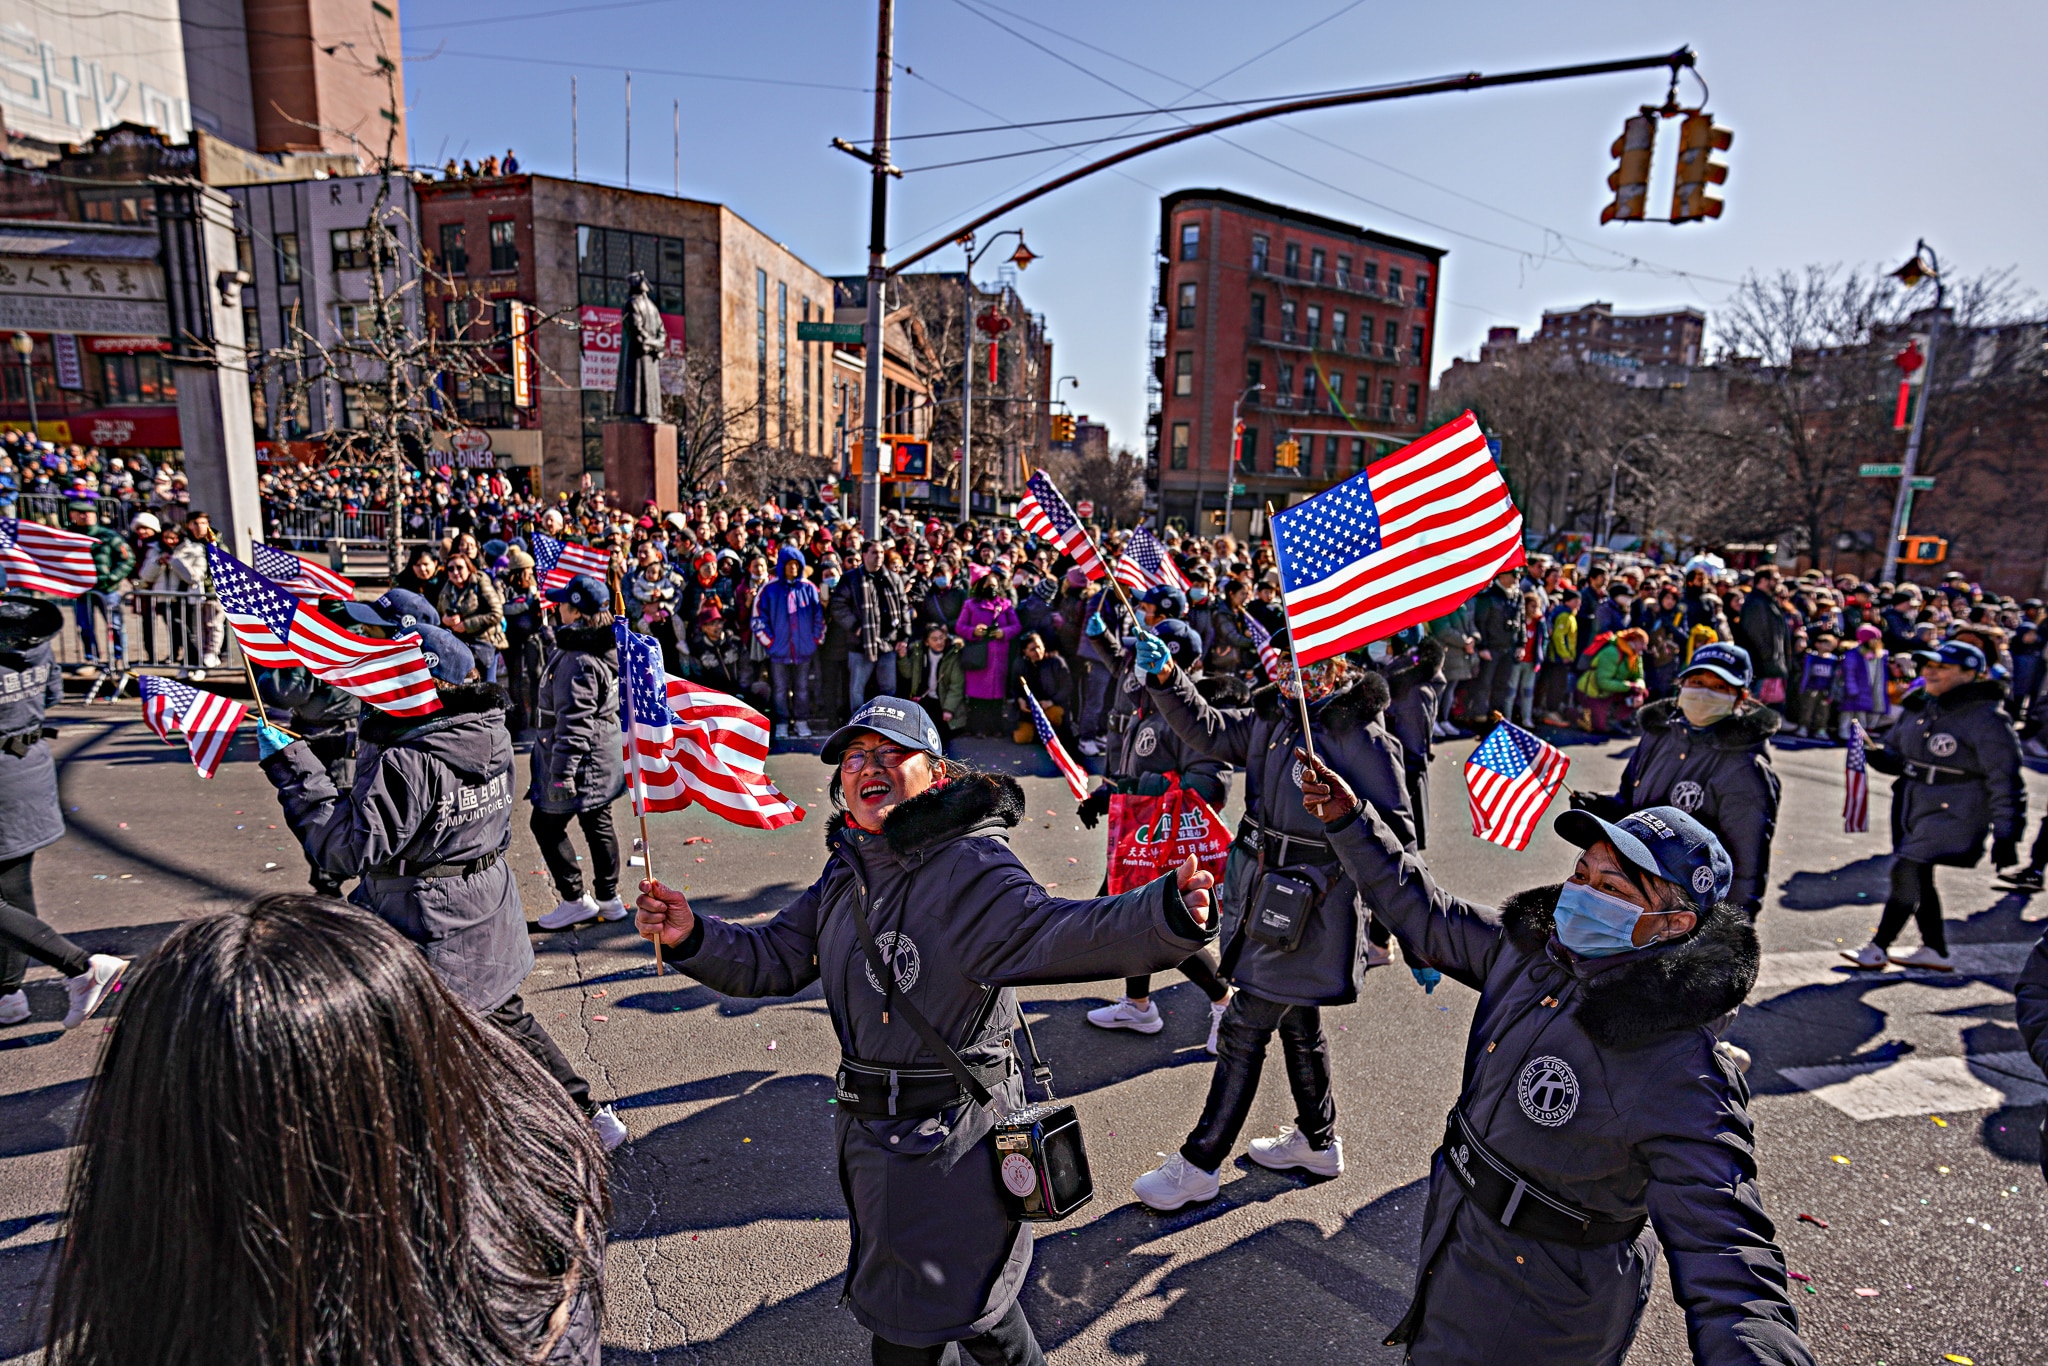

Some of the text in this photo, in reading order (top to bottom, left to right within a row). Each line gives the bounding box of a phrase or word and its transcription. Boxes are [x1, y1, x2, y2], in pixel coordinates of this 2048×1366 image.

[458, 451, 494, 468] DINER
[1521, 1066, 1570, 1120] INTERNATIONAL
[1543, 1061, 1574, 1095] KIWANIS
